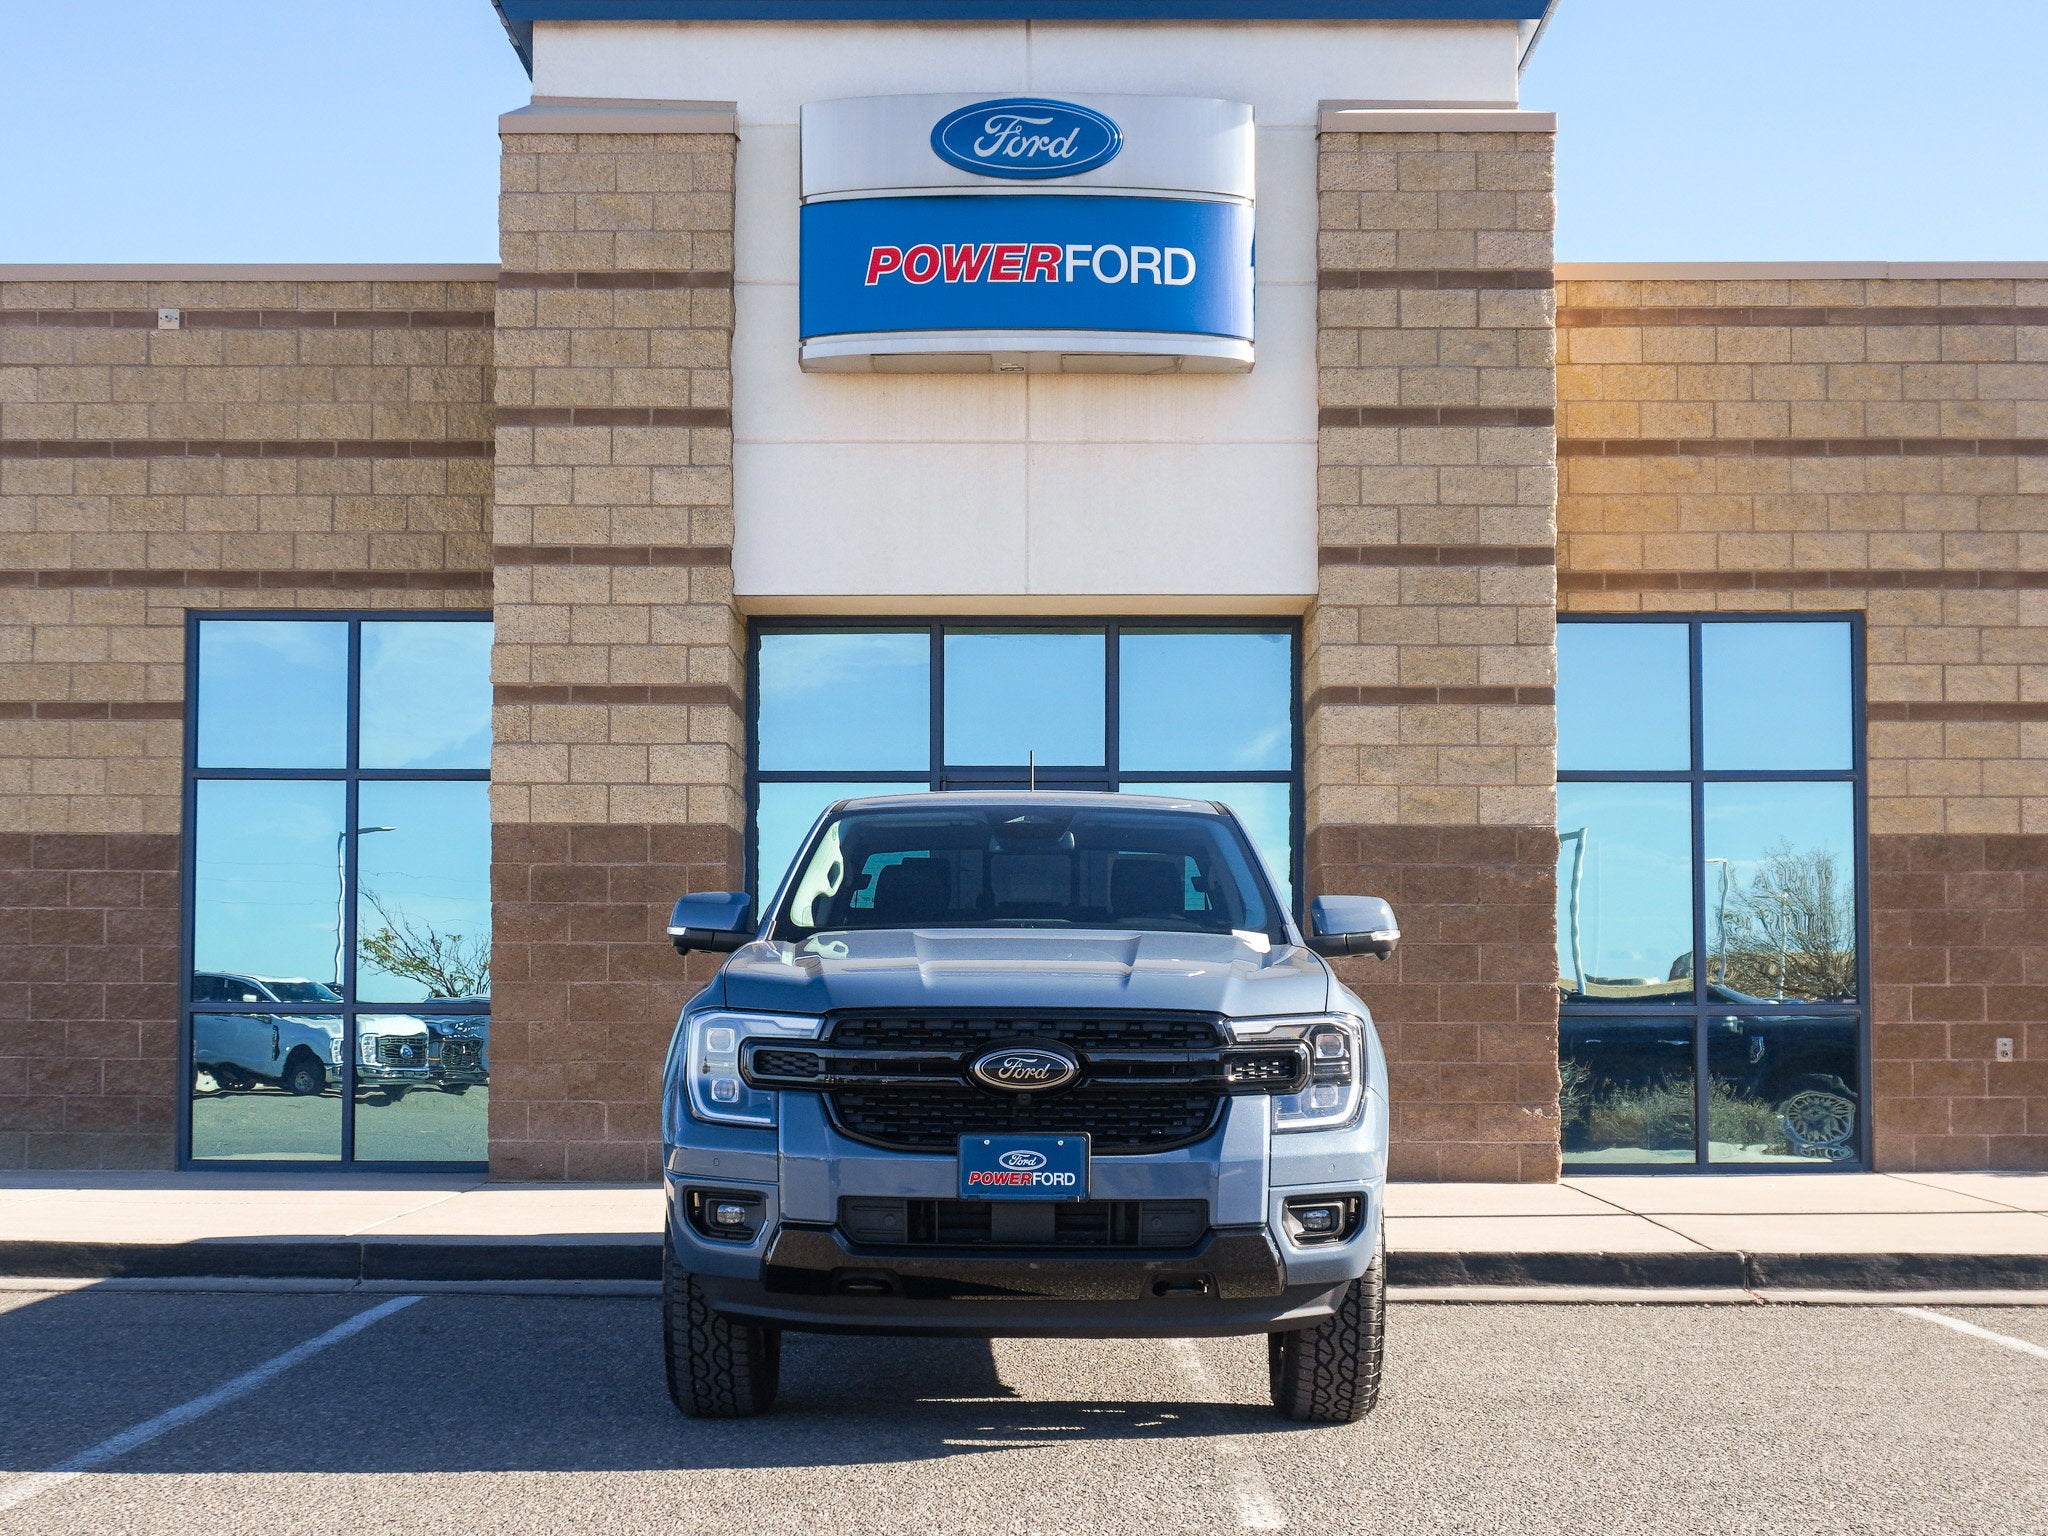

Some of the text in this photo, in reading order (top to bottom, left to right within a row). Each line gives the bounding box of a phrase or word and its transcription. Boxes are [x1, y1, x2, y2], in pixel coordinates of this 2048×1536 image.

[974, 114, 1080, 159] Ford
[864, 243, 1196, 286] POWERFORD
[998, 1057, 1051, 1079] Ford
[1008, 1154, 1037, 1166] Ford
